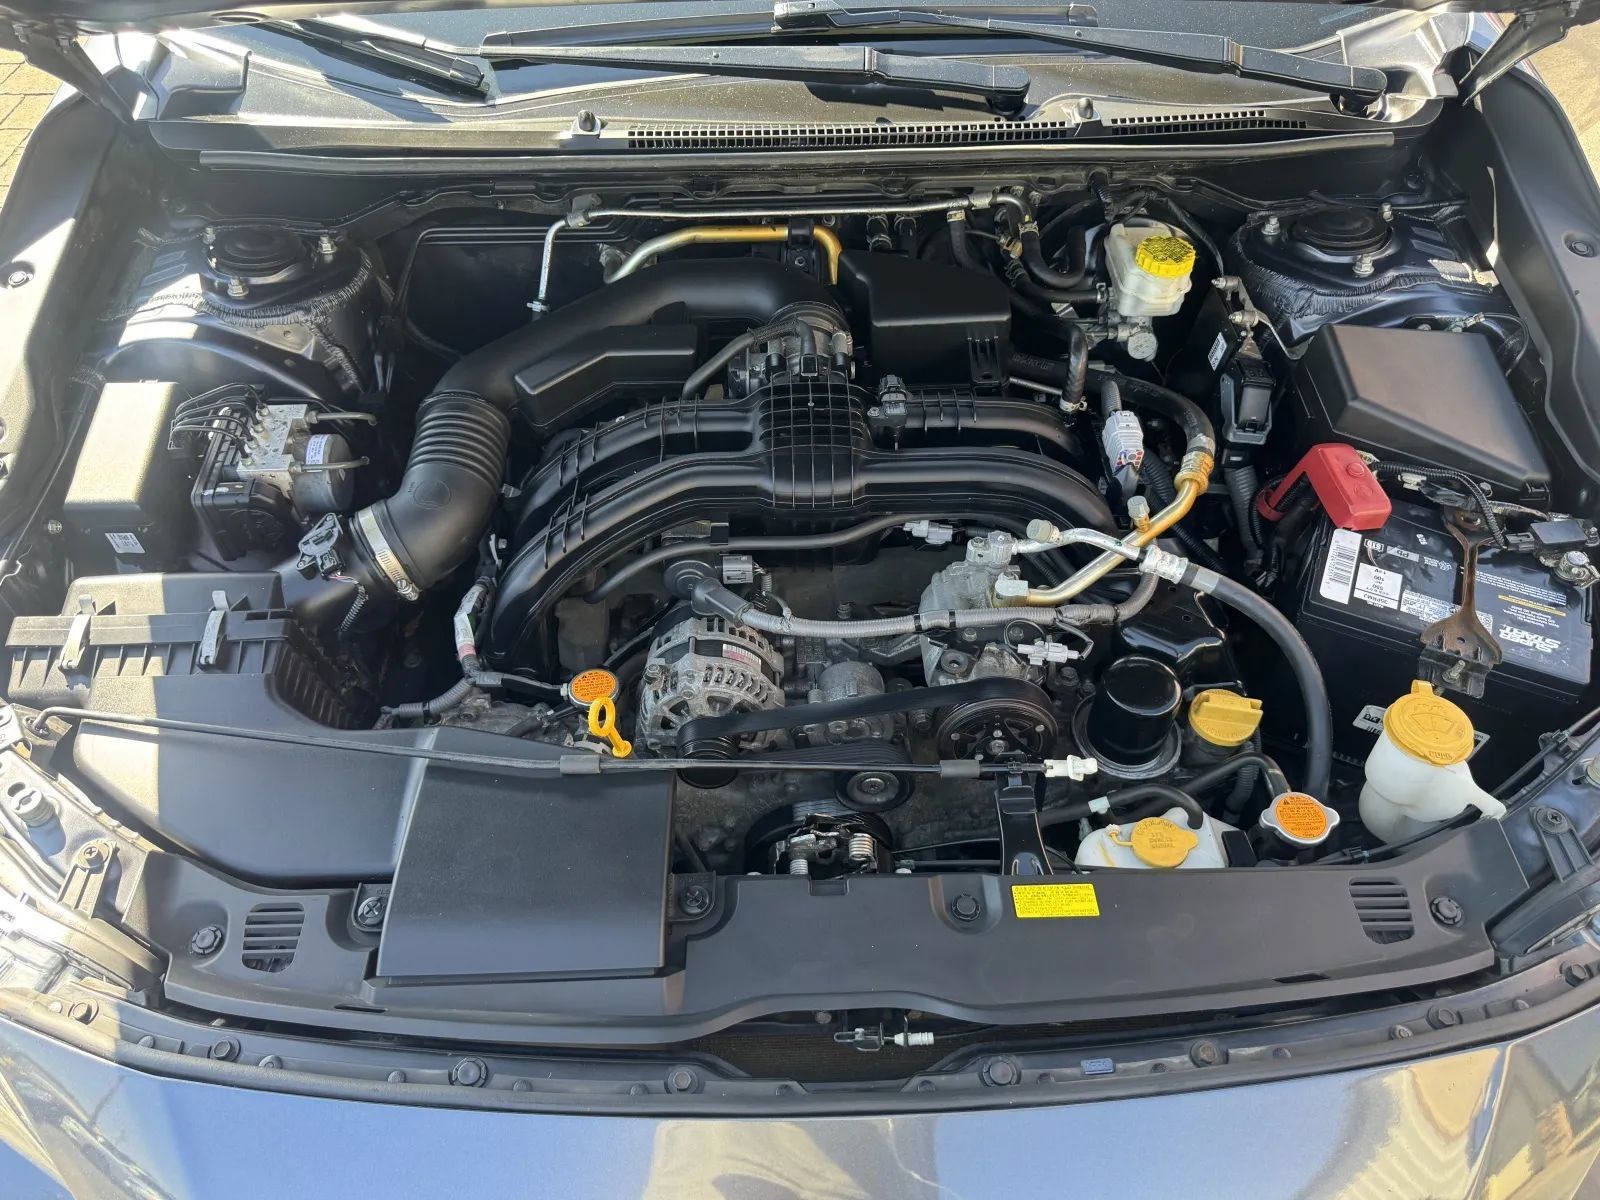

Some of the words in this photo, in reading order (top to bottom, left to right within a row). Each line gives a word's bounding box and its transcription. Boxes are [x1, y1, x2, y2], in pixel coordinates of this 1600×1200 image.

[1397, 550, 1409, 558] Pb
[1499, 629, 1552, 653] SUPER
[1500, 624, 1561, 648] START
